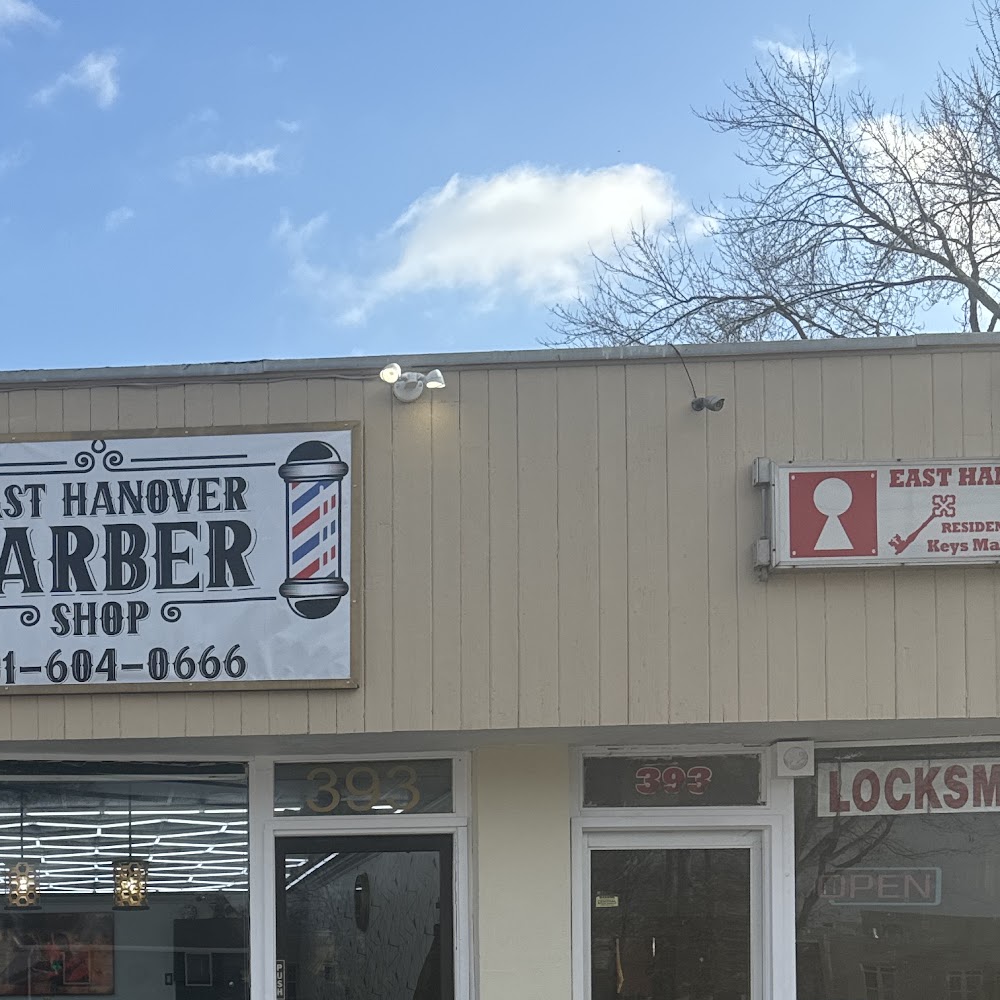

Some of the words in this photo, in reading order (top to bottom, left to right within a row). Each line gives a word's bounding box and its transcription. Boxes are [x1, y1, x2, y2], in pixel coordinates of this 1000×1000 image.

[890, 468, 952, 487] EAST
[959, 466, 1000, 486] HA
[62, 476, 249, 516] HANOVER
[927, 539, 969, 555] Keys
[50, 600, 151, 637] SHOP
[306, 766, 421, 812] 393
[635, 766, 712, 795] 393
[829, 764, 1000, 812] LOCKSM
[818, 873, 931, 899] OPEN
